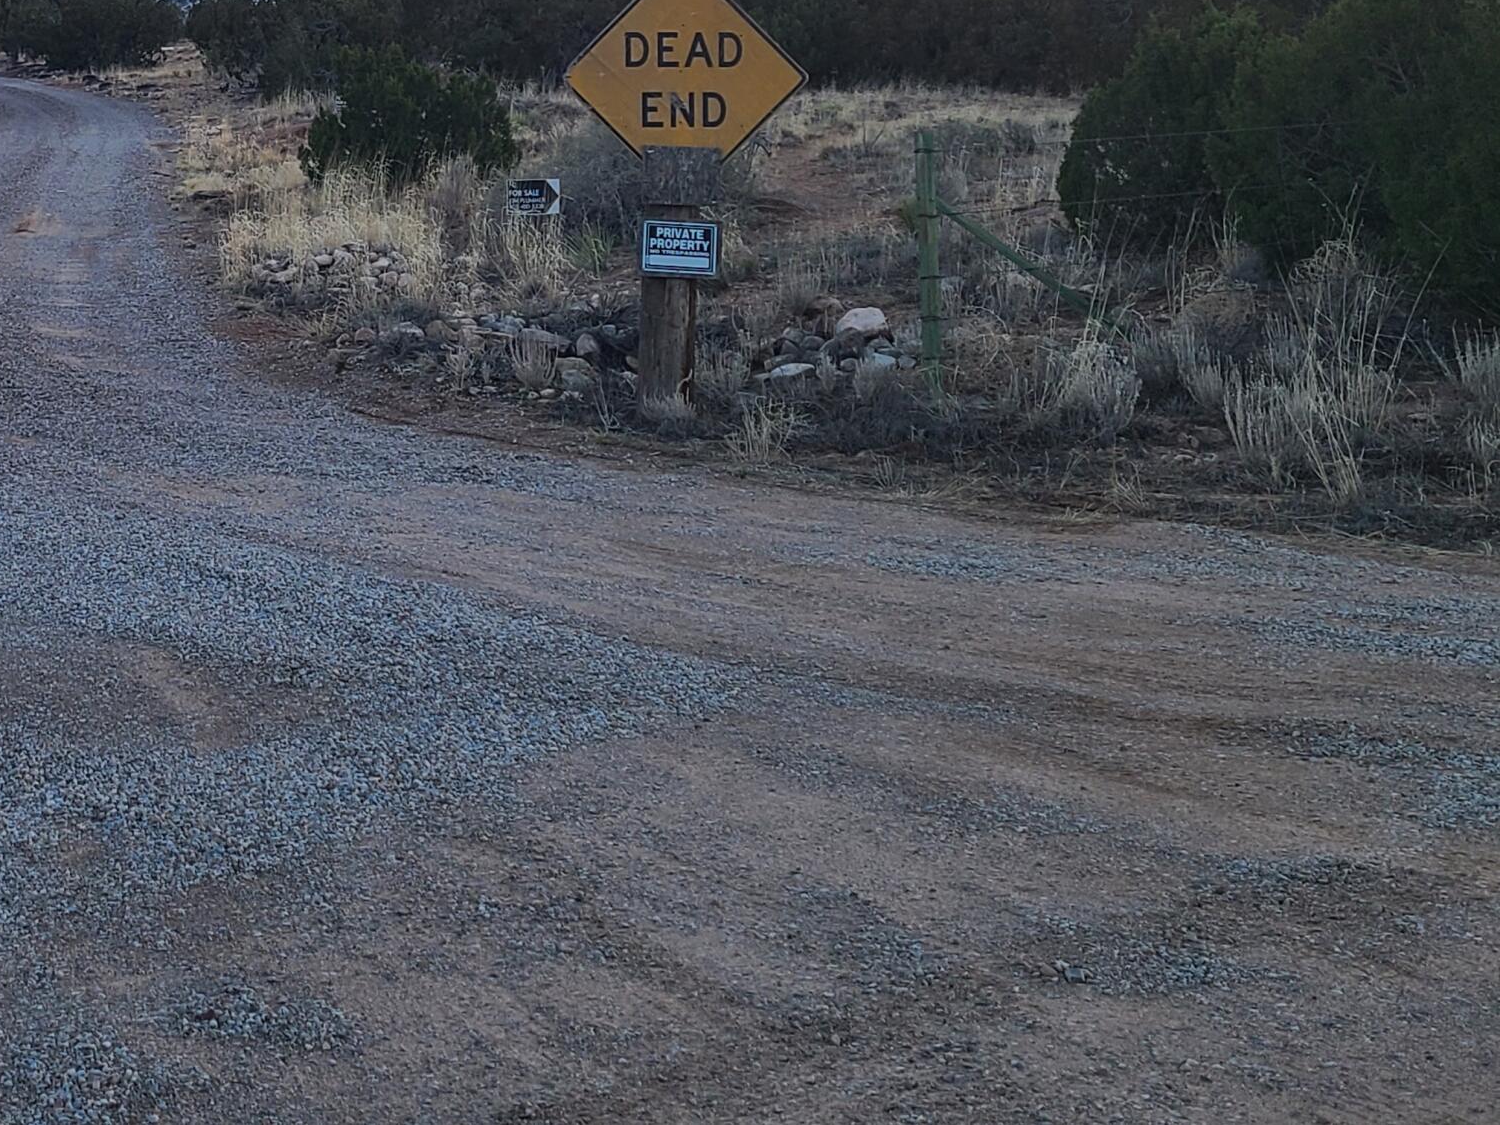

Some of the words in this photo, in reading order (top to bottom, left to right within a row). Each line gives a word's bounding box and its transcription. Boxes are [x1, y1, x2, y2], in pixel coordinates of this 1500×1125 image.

[624, 32, 743, 68] DEAD
[641, 91, 727, 129] END
[509, 189, 522, 197] FOR
[523, 189, 540, 197] SALE
[656, 226, 705, 240] PRIVATE
[649, 237, 710, 252] PROPERTY
